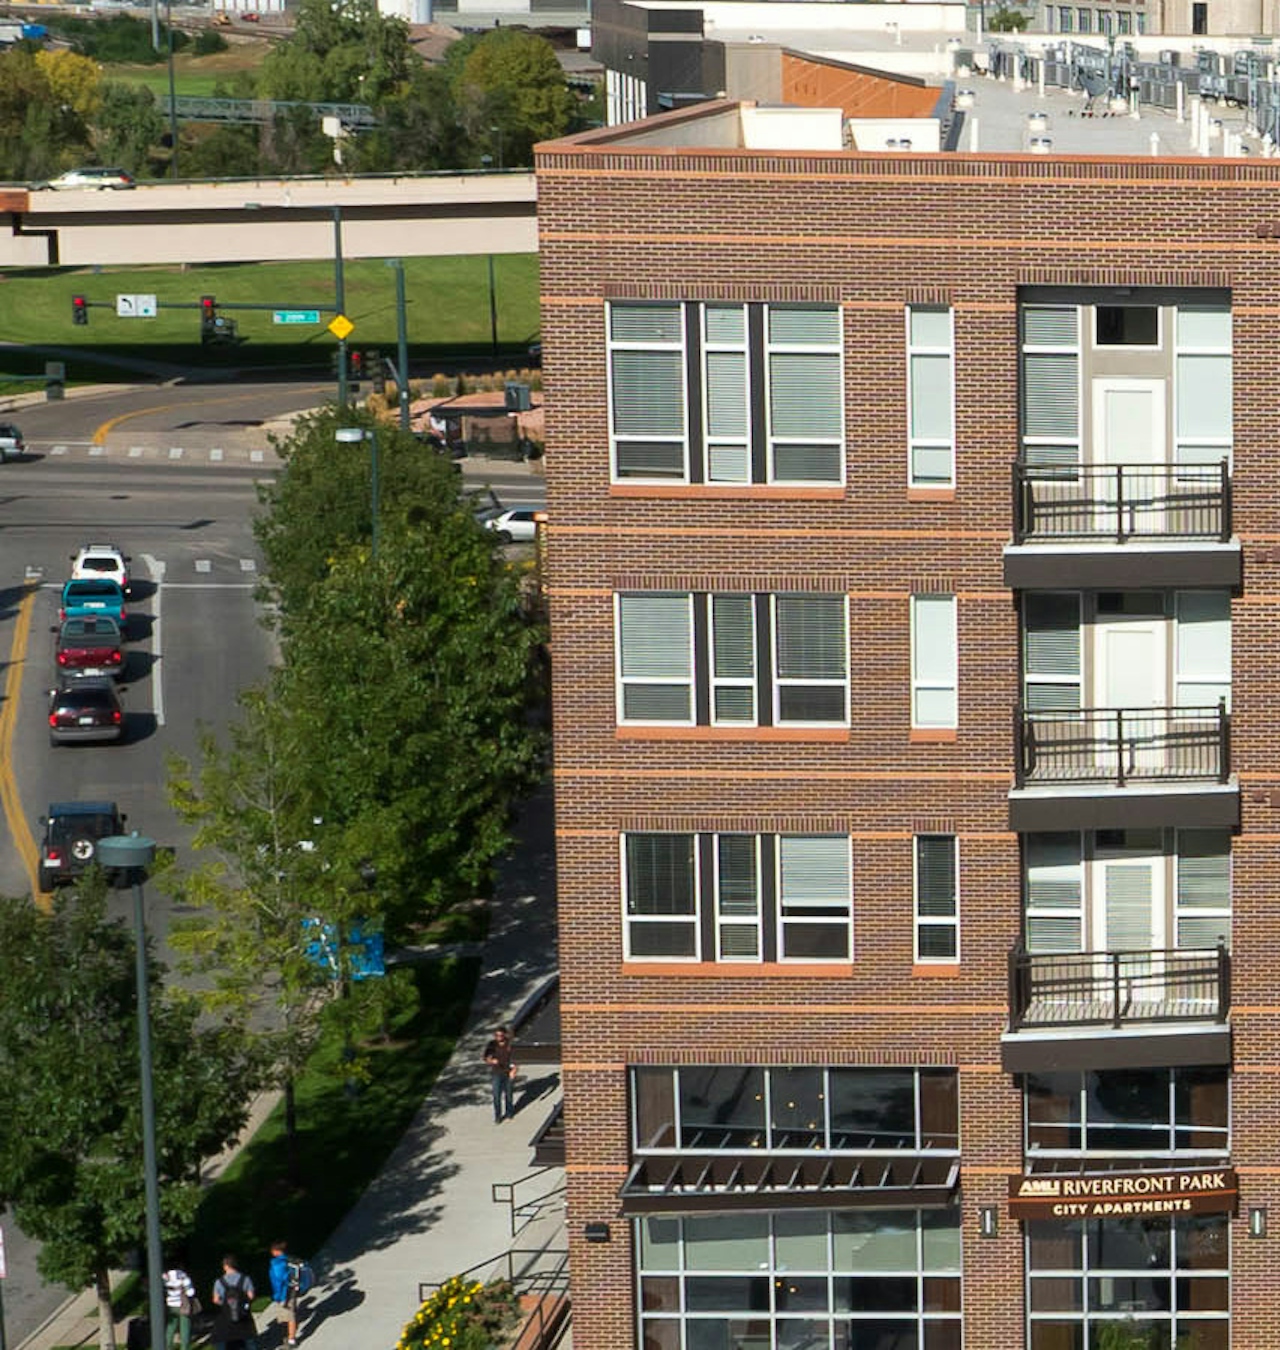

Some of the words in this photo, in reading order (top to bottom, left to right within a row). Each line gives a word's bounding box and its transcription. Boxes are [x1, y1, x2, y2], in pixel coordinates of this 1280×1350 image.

[1018, 1180, 1060, 1195] AMLI
[1063, 1177, 1175, 1196] RIVERFRONT
[1179, 1174, 1226, 1191] PARK
[1053, 1203, 1089, 1216] CITY
[1093, 1200, 1191, 1215] APARTMENTS
